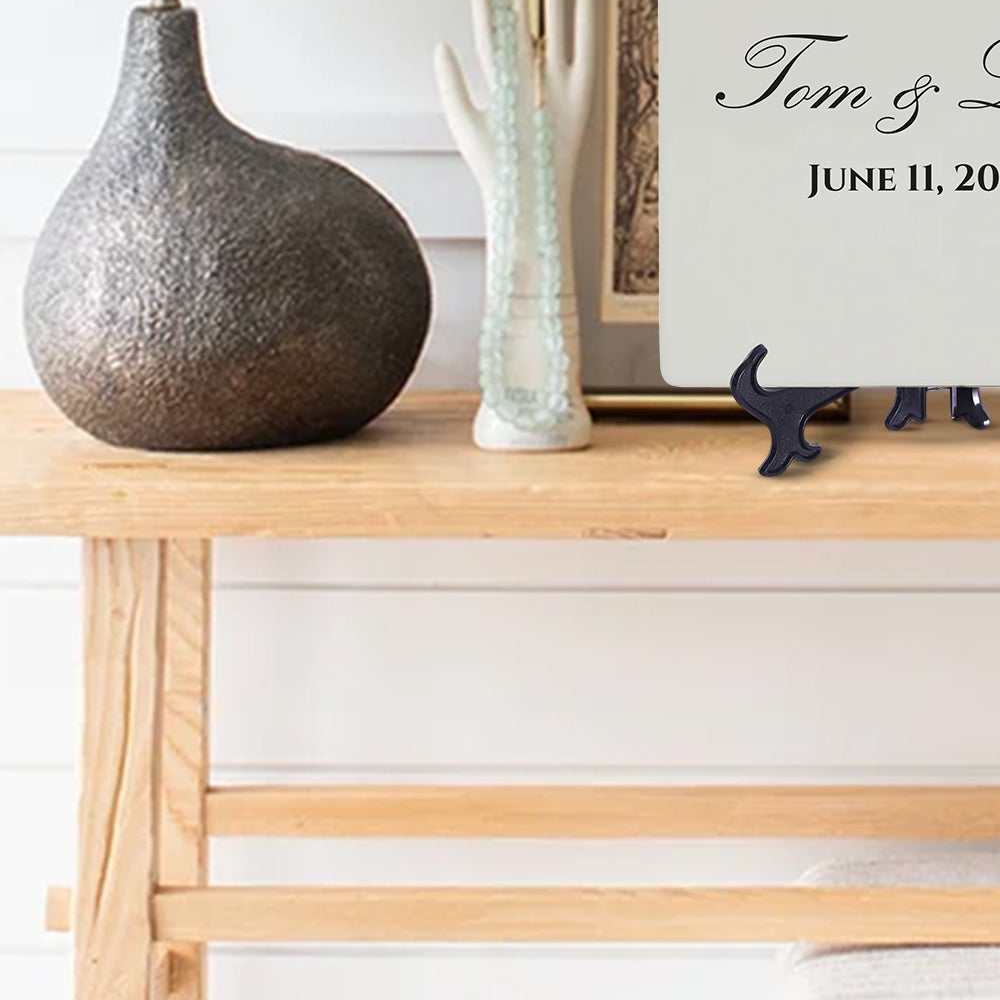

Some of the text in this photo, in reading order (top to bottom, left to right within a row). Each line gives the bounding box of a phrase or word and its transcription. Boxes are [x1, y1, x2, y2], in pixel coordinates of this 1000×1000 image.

[714, 33, 873, 109] Tom
[875, 74, 940, 135] &
[807, 163, 897, 199] JUNE
[908, 163, 944, 196] 11,
